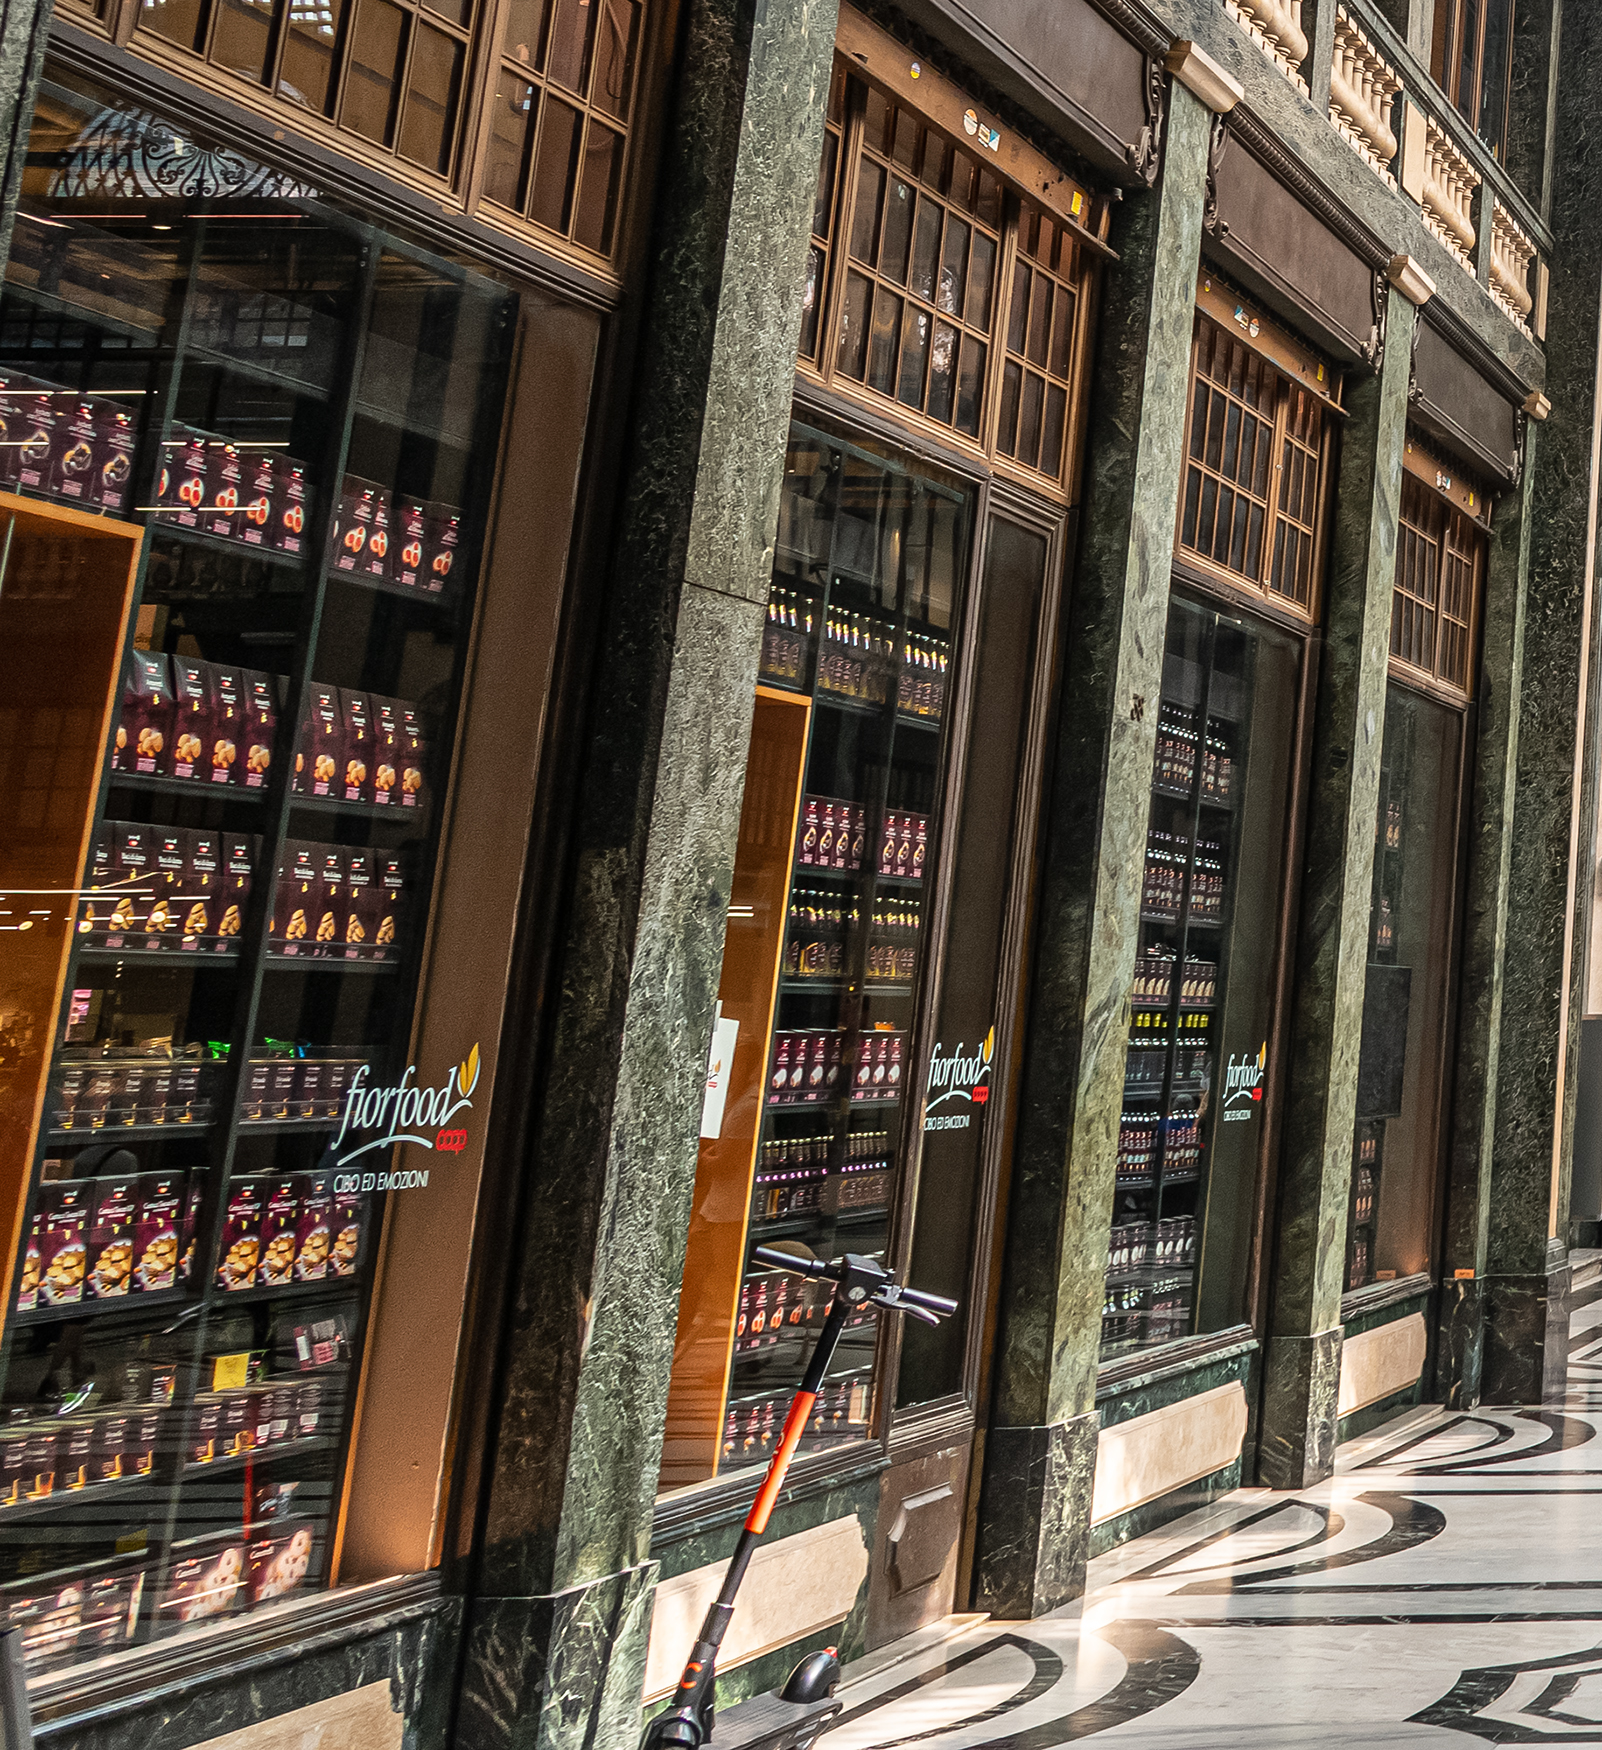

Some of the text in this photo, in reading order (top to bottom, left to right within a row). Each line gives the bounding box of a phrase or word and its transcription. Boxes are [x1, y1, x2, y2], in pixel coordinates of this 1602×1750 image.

[927, 1042, 991, 1100] fiorfood
[331, 1064, 472, 1150] fiorfood
[333, 1169, 430, 1193] CIBO ED EMOZIONI
